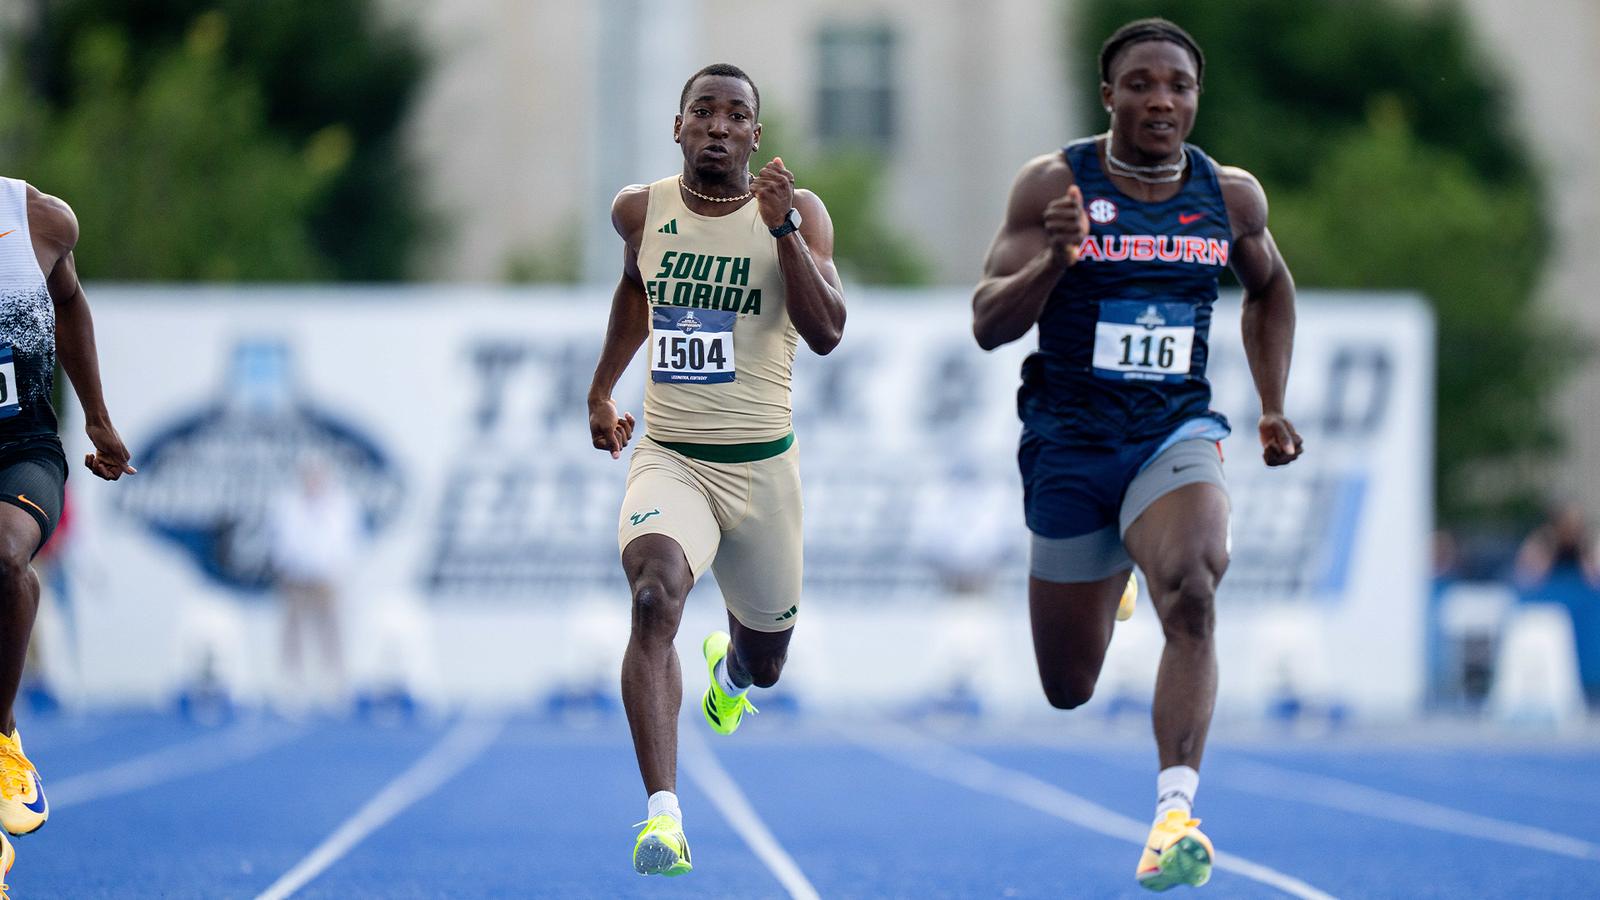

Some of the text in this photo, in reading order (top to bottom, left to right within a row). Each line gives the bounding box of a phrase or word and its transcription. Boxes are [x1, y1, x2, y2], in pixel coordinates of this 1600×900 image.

[1077, 234, 1229, 266] AUBURN
[655, 251, 751, 286] SOUTH
[646, 281, 762, 315] FLORIDA
[657, 336, 727, 370] 1504
[1118, 334, 1176, 368] 116
